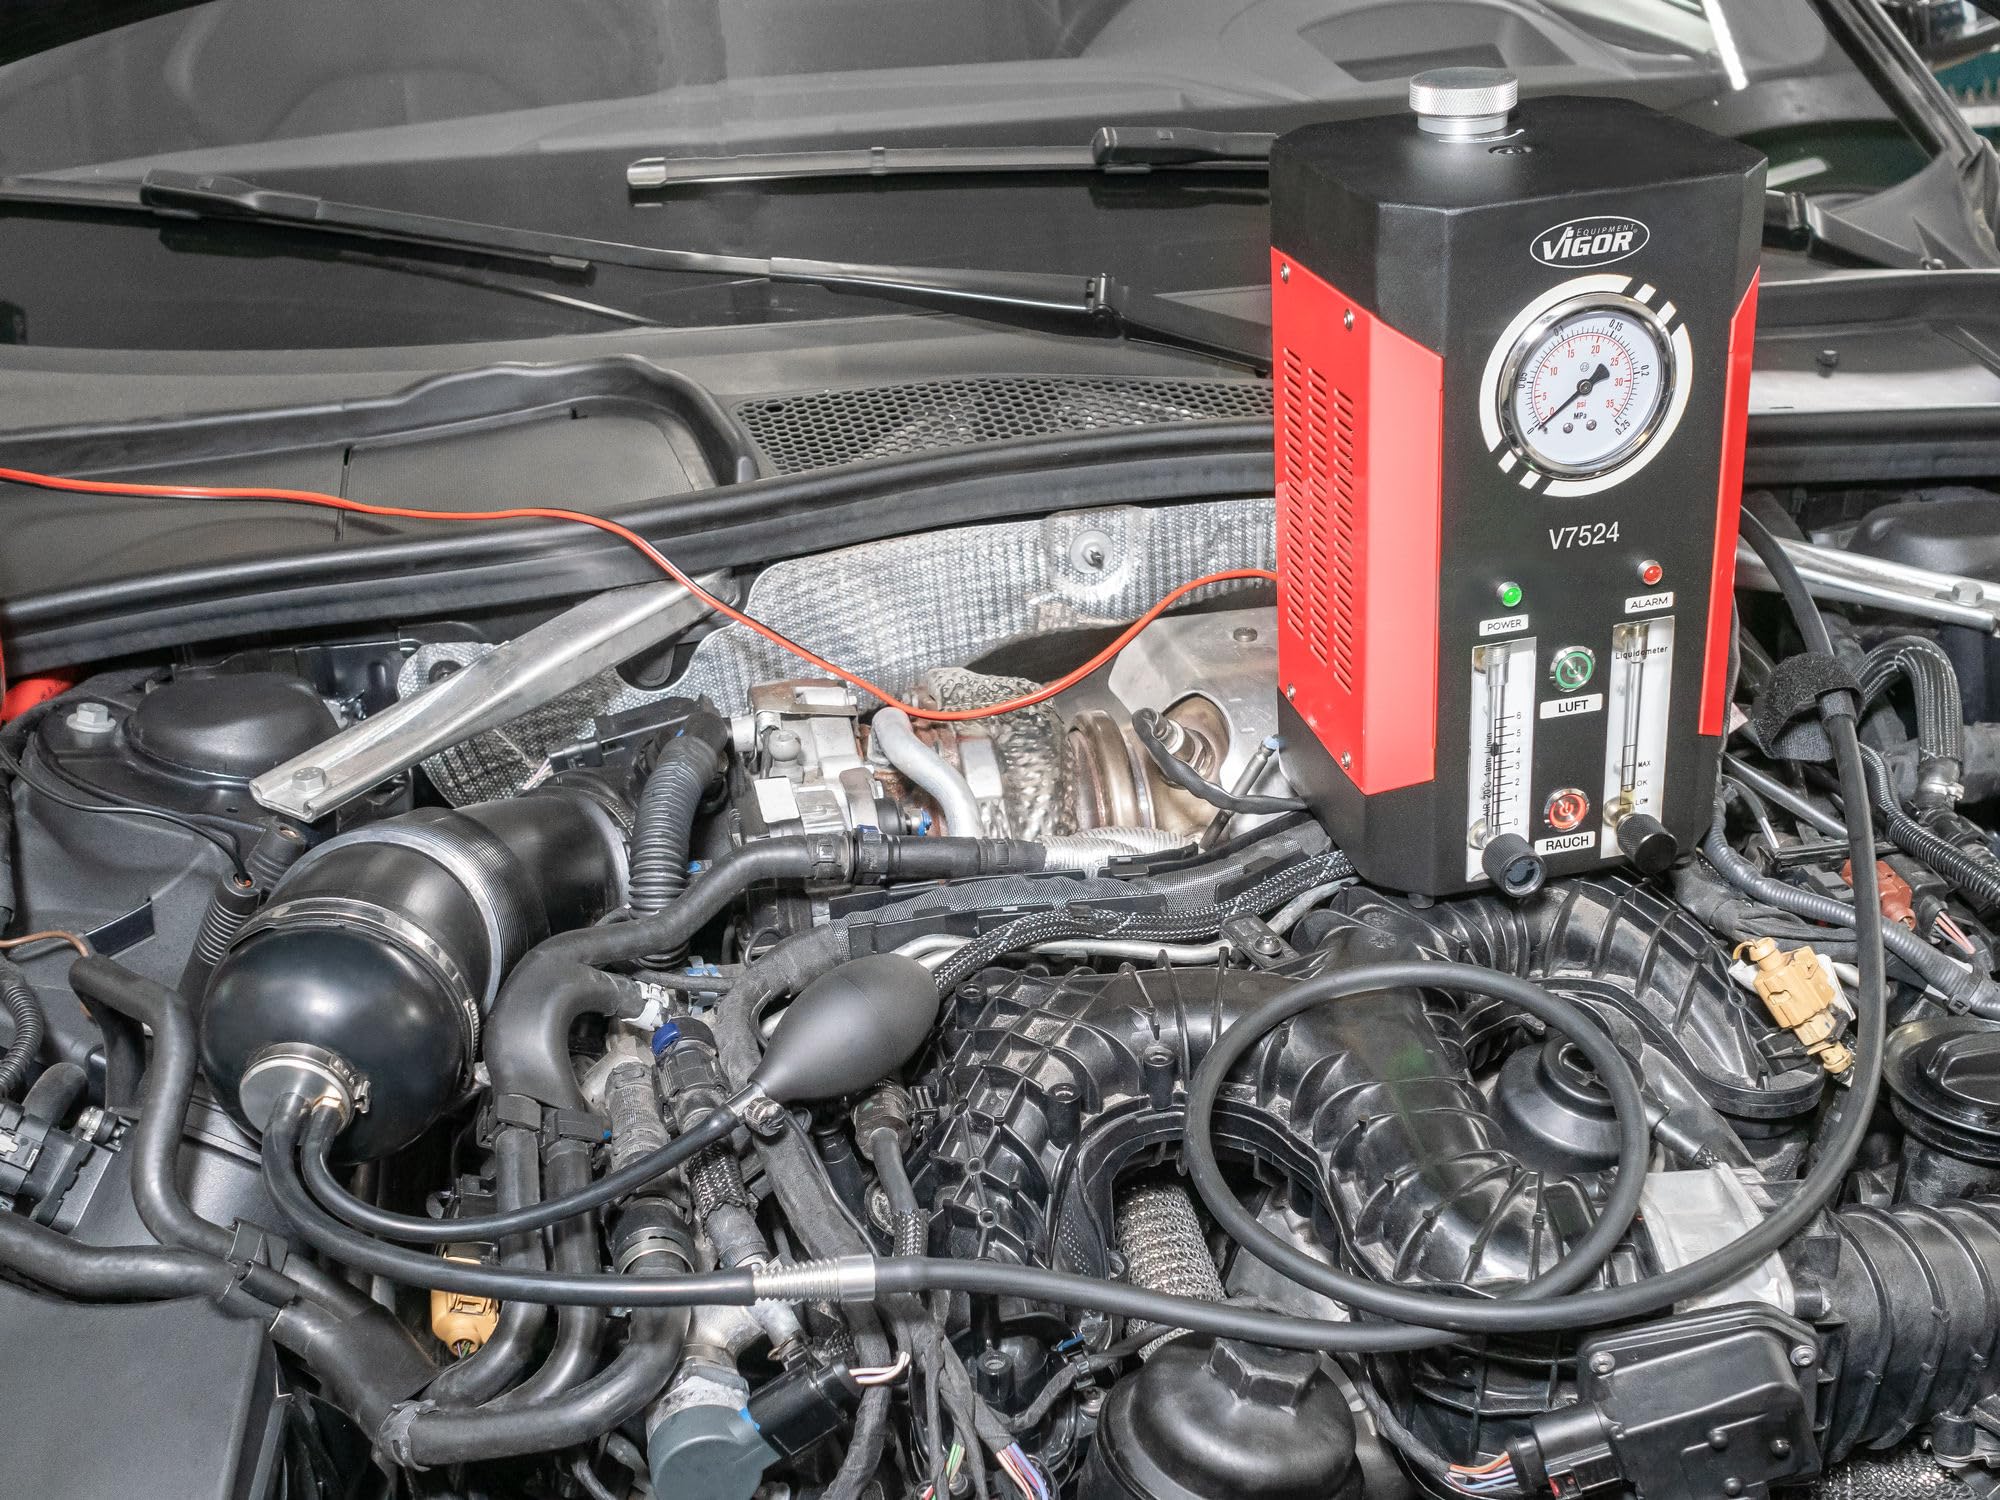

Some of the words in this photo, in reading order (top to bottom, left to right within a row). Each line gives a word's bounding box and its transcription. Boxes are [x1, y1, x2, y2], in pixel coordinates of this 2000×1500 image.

[1577, 223, 1635, 237] EQUIPMENT
[1609, 318, 1623, 332] 0.15
[1567, 349, 1575, 359] 15
[1591, 344, 1600, 355] 20
[1610, 357, 1619, 367] 25
[1550, 366, 1558, 377] 10
[1641, 364, 1650, 377] 0.2
[1615, 377, 1624, 387] 30
[1542, 391, 1547, 401] 5
[1576, 400, 1587, 410] psi
[1606, 399, 1615, 409] 35
[1527, 427, 1535, 435] 0
[1614, 419, 1631, 436] 0.25
[1548, 521, 1620, 550] V7524
[1631, 596, 1668, 609] ALARM
[1487, 618, 1522, 632] POWER
[1558, 699, 1589, 713] LUFT
[1637, 760, 1652, 768] MAX
[1636, 779, 1648, 787] OK
[1545, 835, 1589, 851] RAUCH
